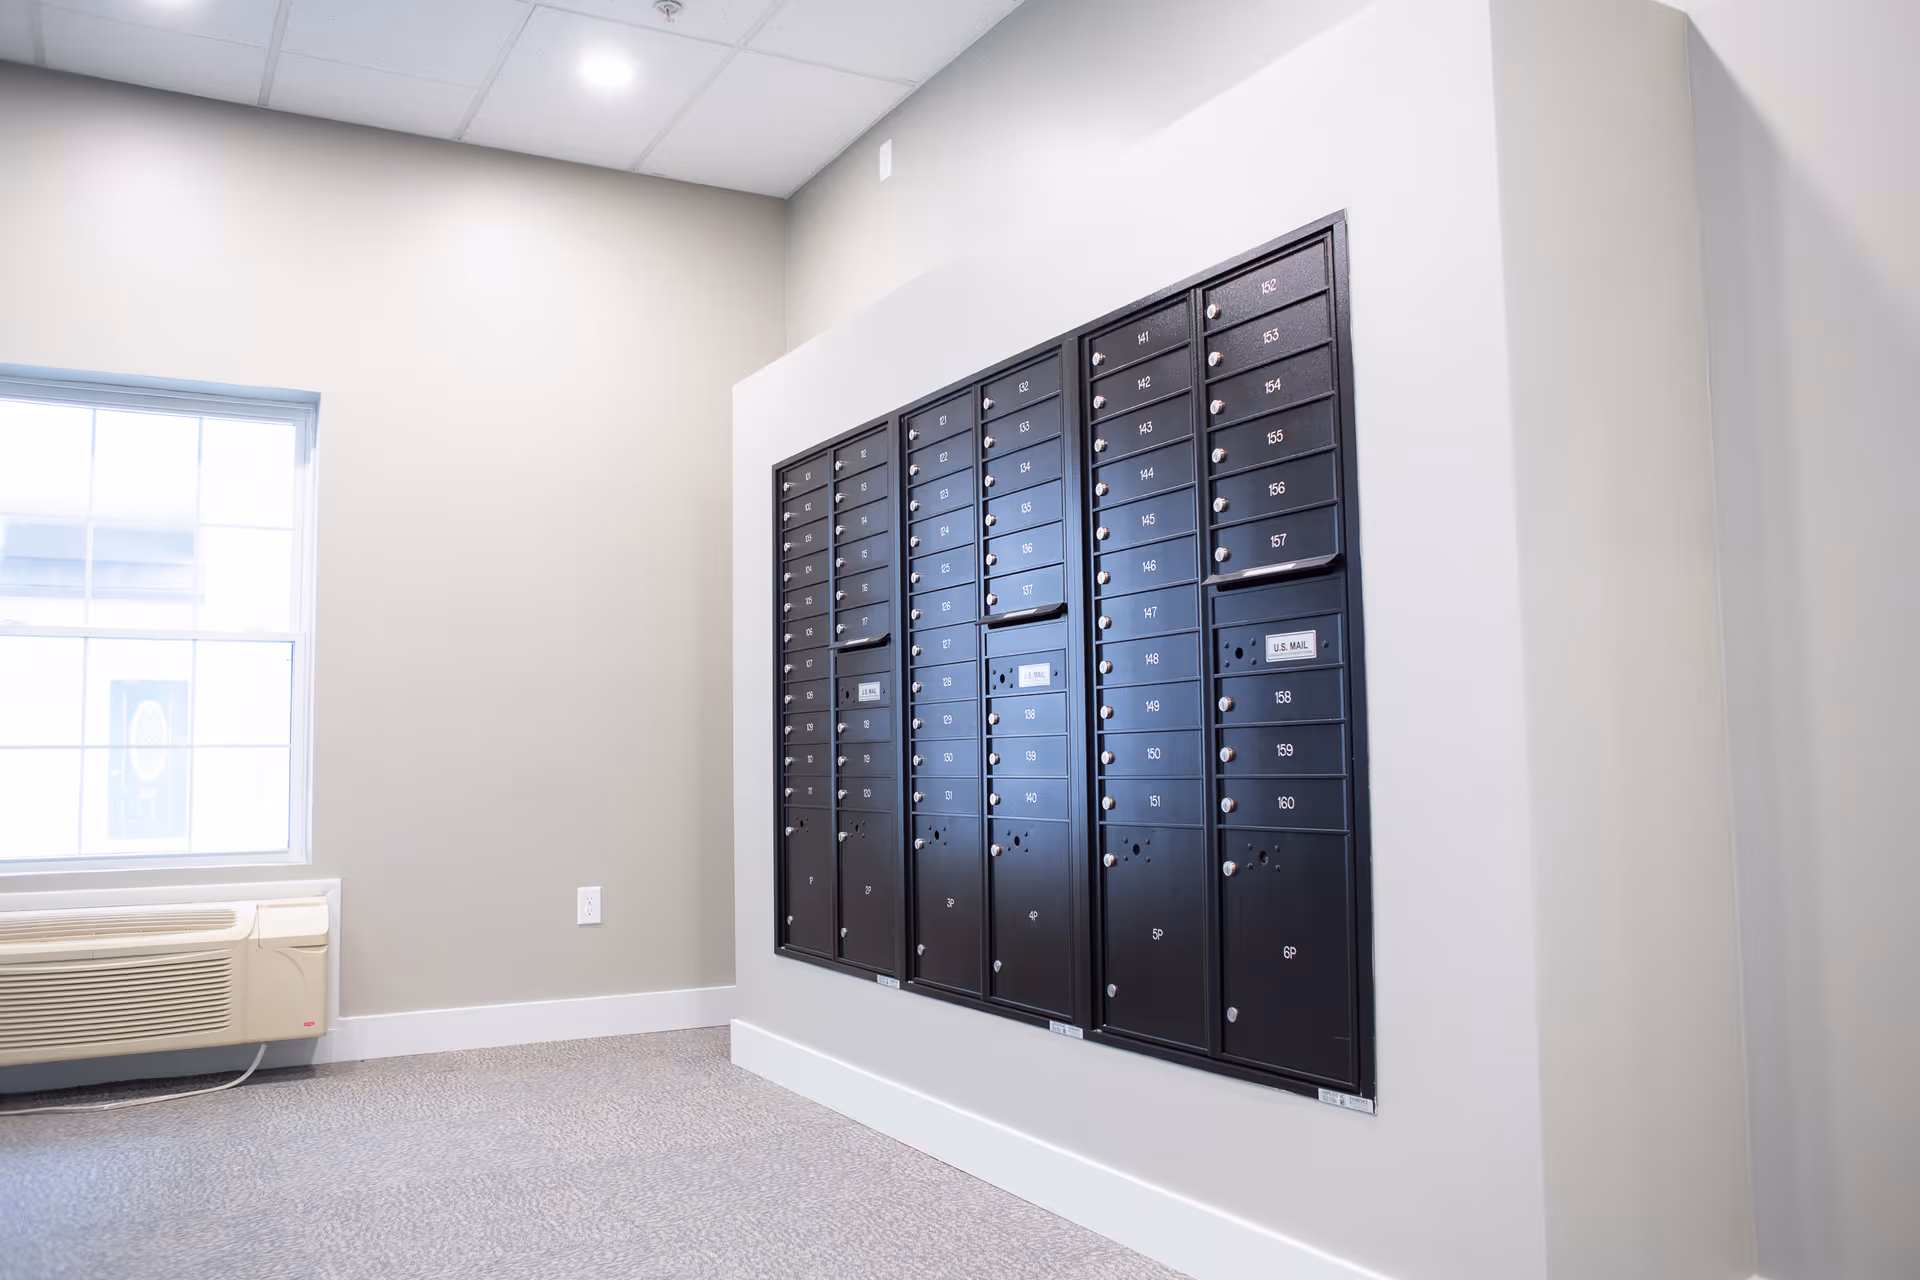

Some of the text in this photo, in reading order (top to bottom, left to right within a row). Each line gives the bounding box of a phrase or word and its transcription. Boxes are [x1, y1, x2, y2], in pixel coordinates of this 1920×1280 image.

[1260, 279, 1277, 295] 152
[1137, 331, 1149, 346] 141
[1262, 328, 1280, 345] 153
[1018, 381, 1029, 394] 132
[1137, 376, 1151, 391] 142
[1264, 378, 1282, 395] 154
[1019, 421, 1030, 434] 133
[1138, 421, 1153, 436] 143
[1266, 429, 1284, 445] 155
[1019, 462, 1031, 474] 134
[1139, 467, 1155, 481] 144
[1268, 481, 1286, 497] 156
[1020, 502, 1032, 514] 135
[1141, 513, 1156, 527] 145
[1270, 533, 1287, 549] 157
[1021, 543, 1033, 554] 136
[1142, 560, 1157, 573] 146
[1022, 584, 1034, 596] 137
[1143, 606, 1158, 619] 147
[1273, 640, 1308, 652] U.S. MAIL
[1144, 653, 1160, 666] 148
[1274, 691, 1292, 704] 158
[1145, 700, 1160, 713] 149
[1024, 709, 1036, 720] 138
[1025, 751, 1037, 762] 139
[1146, 748, 1161, 760] 150
[1276, 744, 1294, 757] 159
[1025, 793, 1038, 804] 140
[1149, 795, 1161, 807] 151
[1277, 796, 1295, 810] 160
[1028, 911, 1039, 922] 4P
[1152, 928, 1164, 941] 5P
[1283, 946, 1297, 960] 6P
